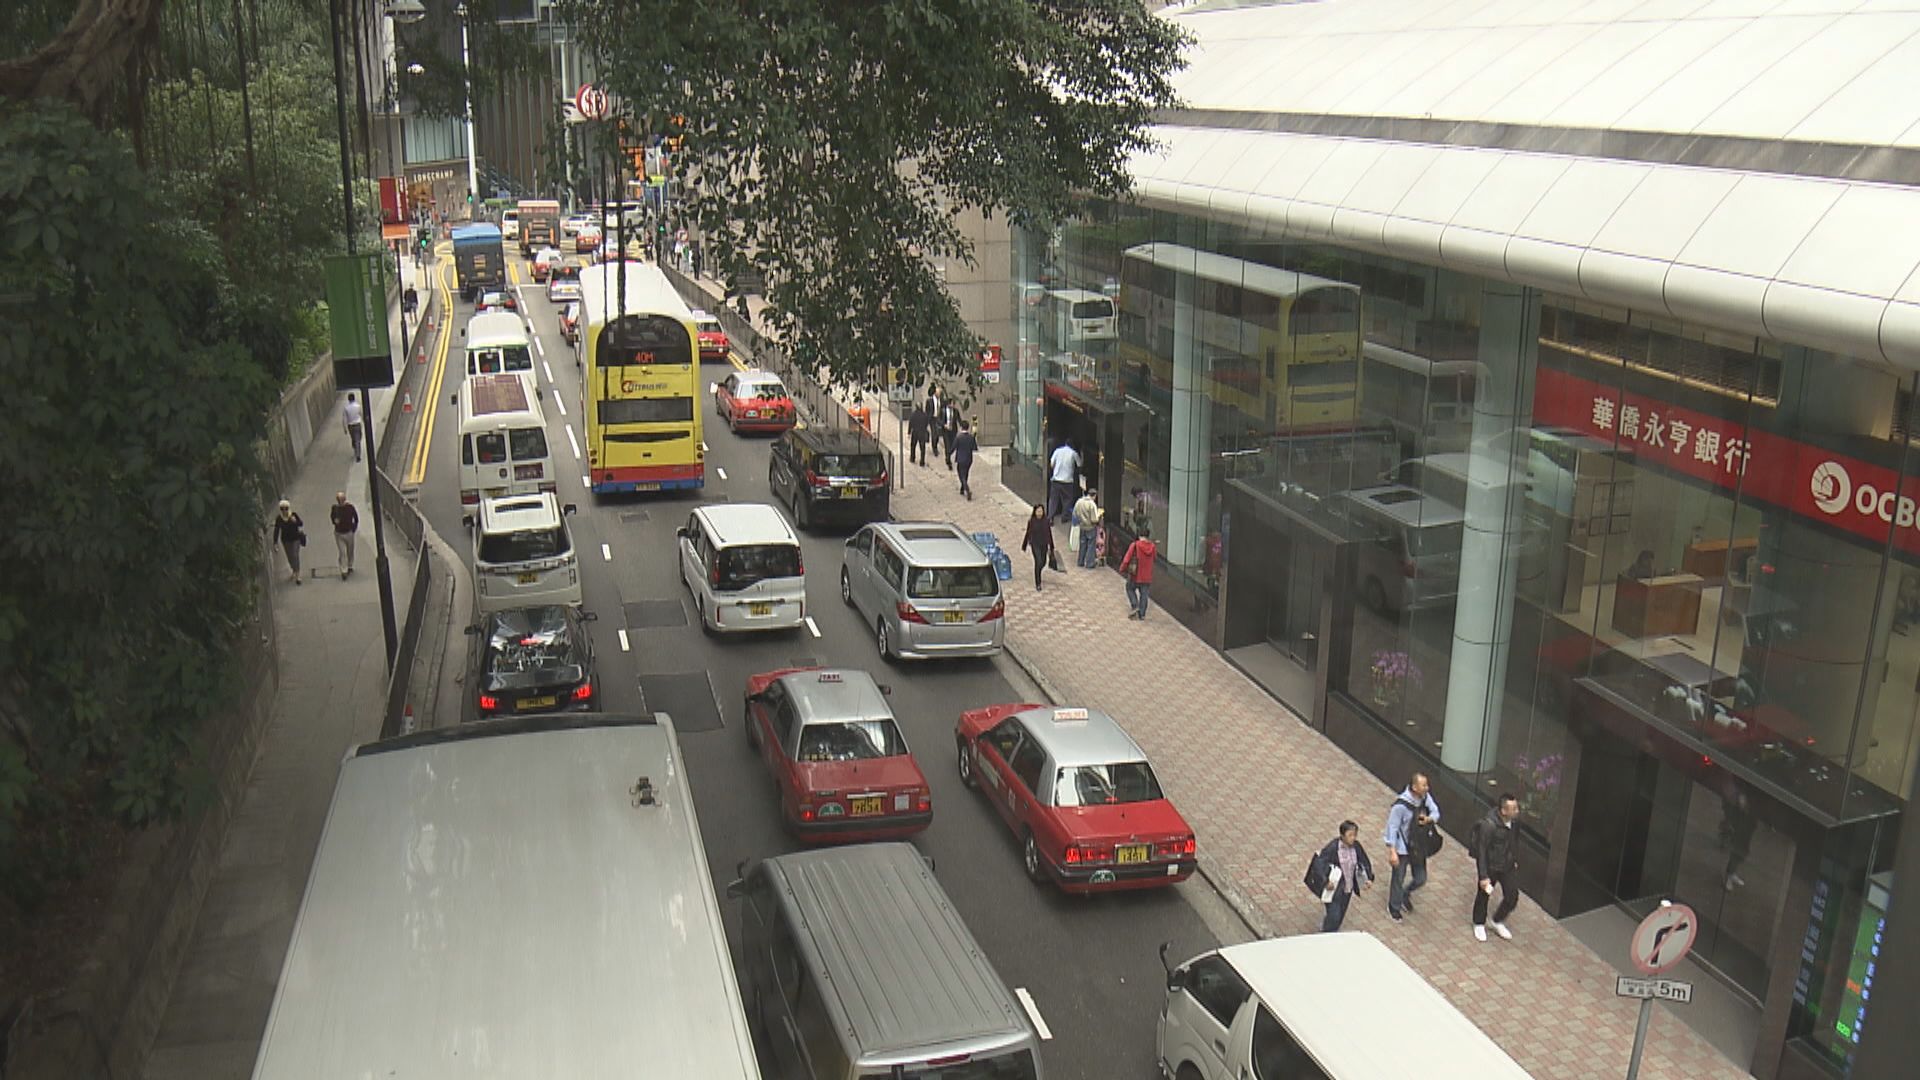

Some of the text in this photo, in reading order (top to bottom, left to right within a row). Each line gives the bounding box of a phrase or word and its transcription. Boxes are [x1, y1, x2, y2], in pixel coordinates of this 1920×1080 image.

[413, 169, 454, 184] LONGCHAMP
[1592, 397, 1752, 477] 華僑永亨銀行
[1660, 982, 1686, 999] 5m
